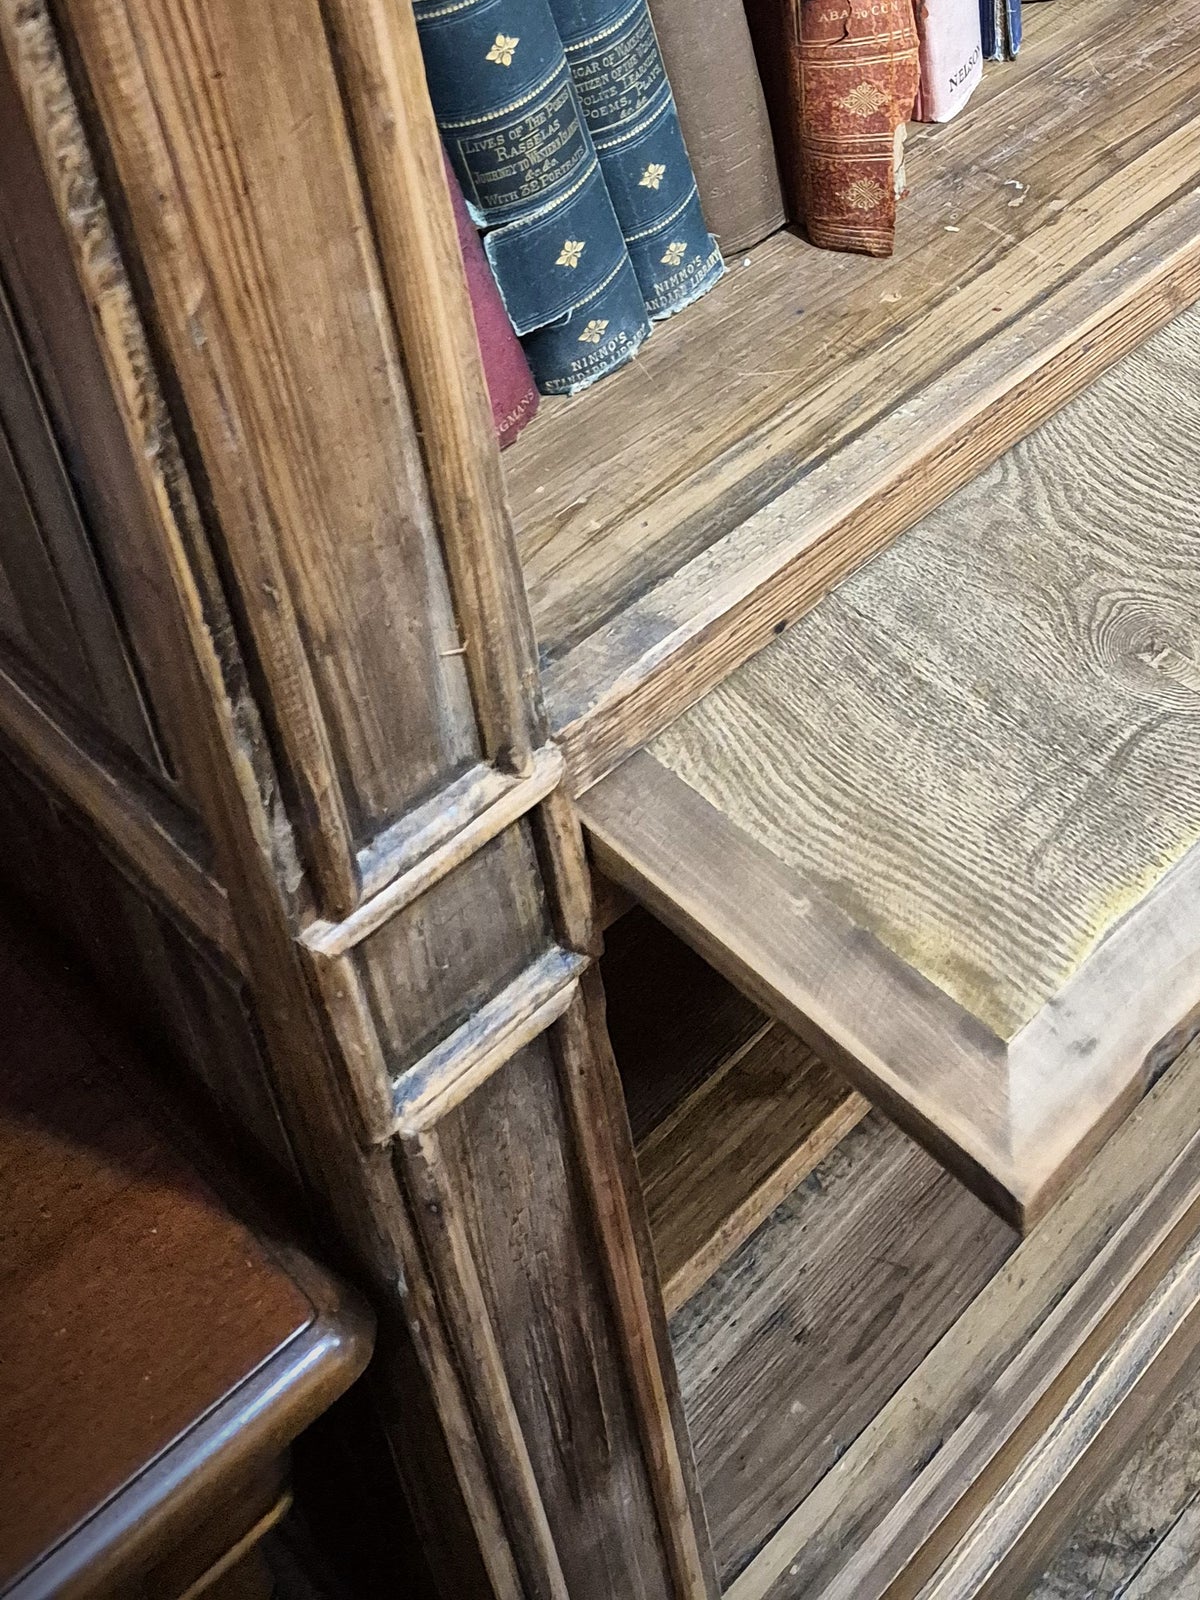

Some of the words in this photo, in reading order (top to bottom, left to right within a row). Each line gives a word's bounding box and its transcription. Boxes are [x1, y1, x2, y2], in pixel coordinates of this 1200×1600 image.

[818, 9, 849, 23] ABA
[573, 62, 601, 78] ICAR
[602, 54, 615, 67] OF
[576, 73, 609, 94] TIZEN
[611, 68, 622, 80] OF
[465, 135, 505, 154] LIVES
[508, 126, 523, 140] OF
[525, 112, 547, 131] THE
[494, 119, 560, 163] RASSELAS
[474, 163, 517, 185] JOURNEY
[484, 190, 519, 206] WITH
[539, 145, 585, 187] PORTRAITS
[653, 254, 703, 298] NIMMO'S
[645, 284, 688, 311] ANDARD
